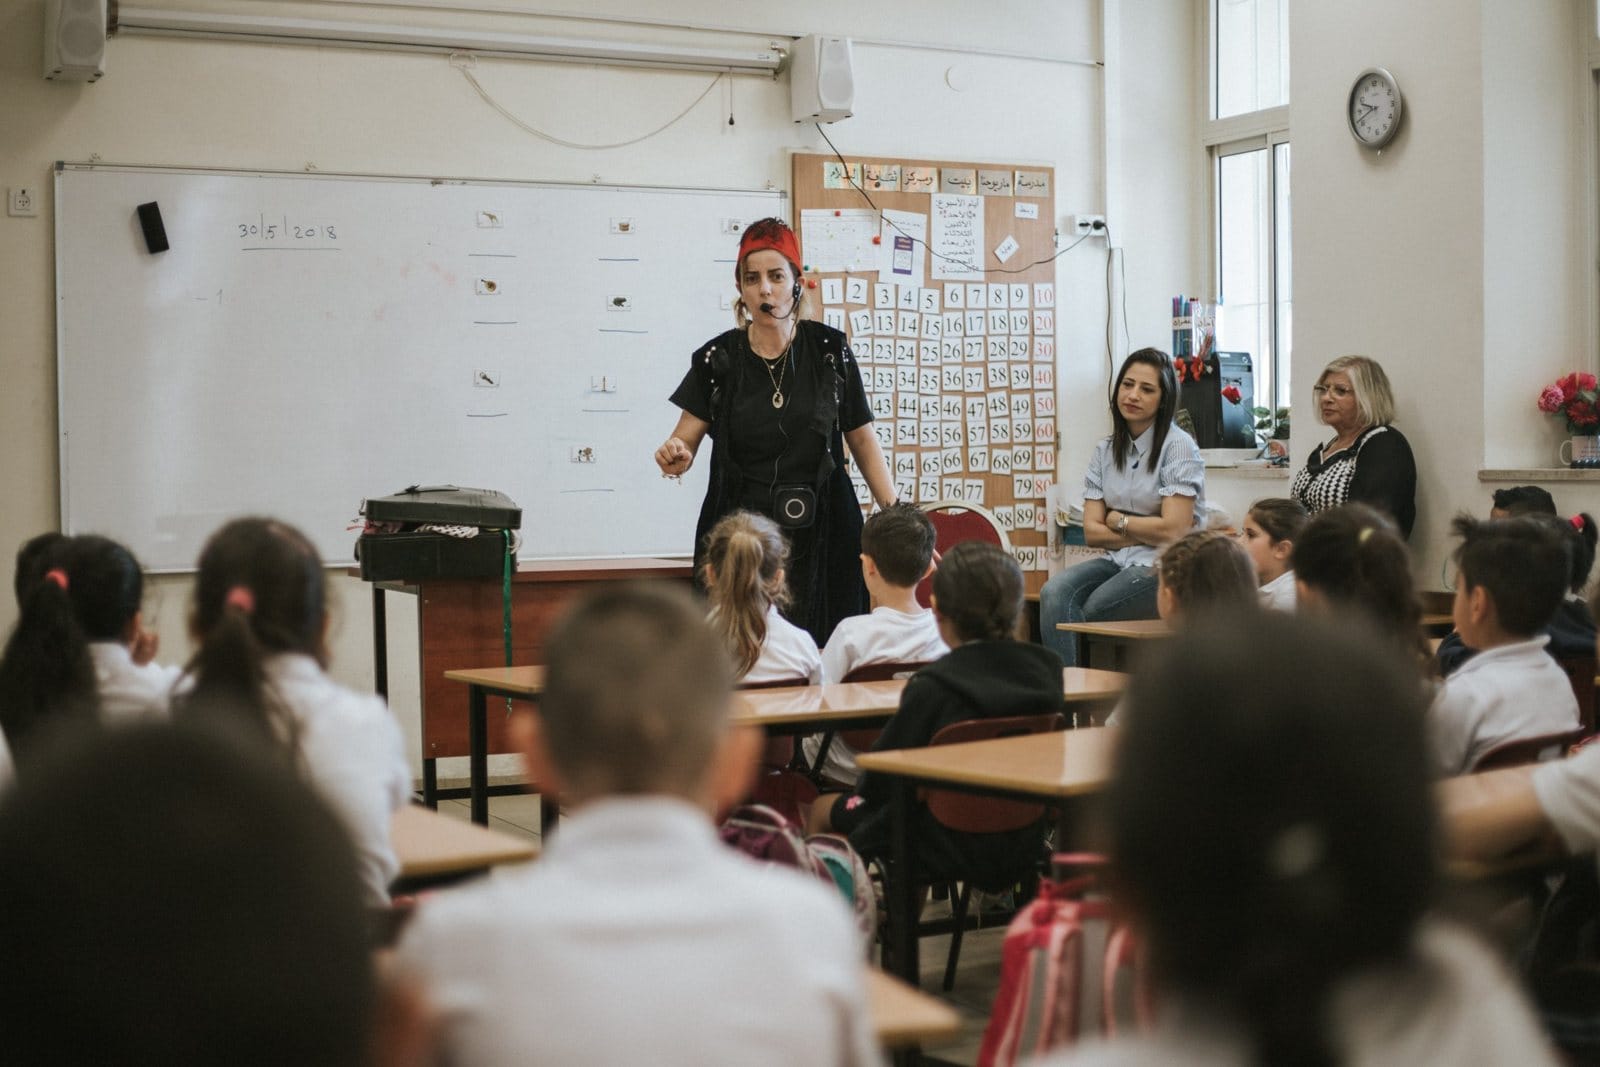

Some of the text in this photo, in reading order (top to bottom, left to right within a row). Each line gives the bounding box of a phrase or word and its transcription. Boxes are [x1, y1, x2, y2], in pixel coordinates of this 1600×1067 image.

[1018, 175, 1045, 190] مدرسة
[830, 284, 1052, 309] 1 2 3 4 5 6 7 8 9 10
[828, 314, 1052, 336] 11 12 13 14 15 16 17 18 19 20
[853, 341, 1051, 361] 22 23 24 25 26 27 28 29 30
[876, 373, 893, 388] 33
[899, 371, 915, 386] 34
[921, 375, 938, 390] 35
[944, 371, 961, 386] 36
[966, 373, 982, 388] 37
[990, 368, 1006, 382] 38
[1012, 369, 1029, 385] 39
[1035, 370, 1050, 384] 40
[874, 396, 1053, 417] 43 44 45 46 47 48 49 50
[876, 423, 1053, 443] 53 54 55 56 57 58 59 60
[897, 457, 915, 473] 64
[922, 457, 939, 472] 65
[943, 453, 960, 468] 66
[970, 451, 986, 466] 67
[993, 454, 1010, 469] 68
[1013, 449, 1031, 465] 69
[1036, 451, 1053, 465] 70
[897, 483, 913, 498] 74
[921, 482, 937, 497] 75
[944, 483, 962, 498] 76
[966, 485, 982, 499] 77
[1016, 479, 1050, 494] 79 80
[996, 512, 1012, 527] 88
[1017, 509, 1033, 524] 89
[1017, 552, 1034, 567] 99
